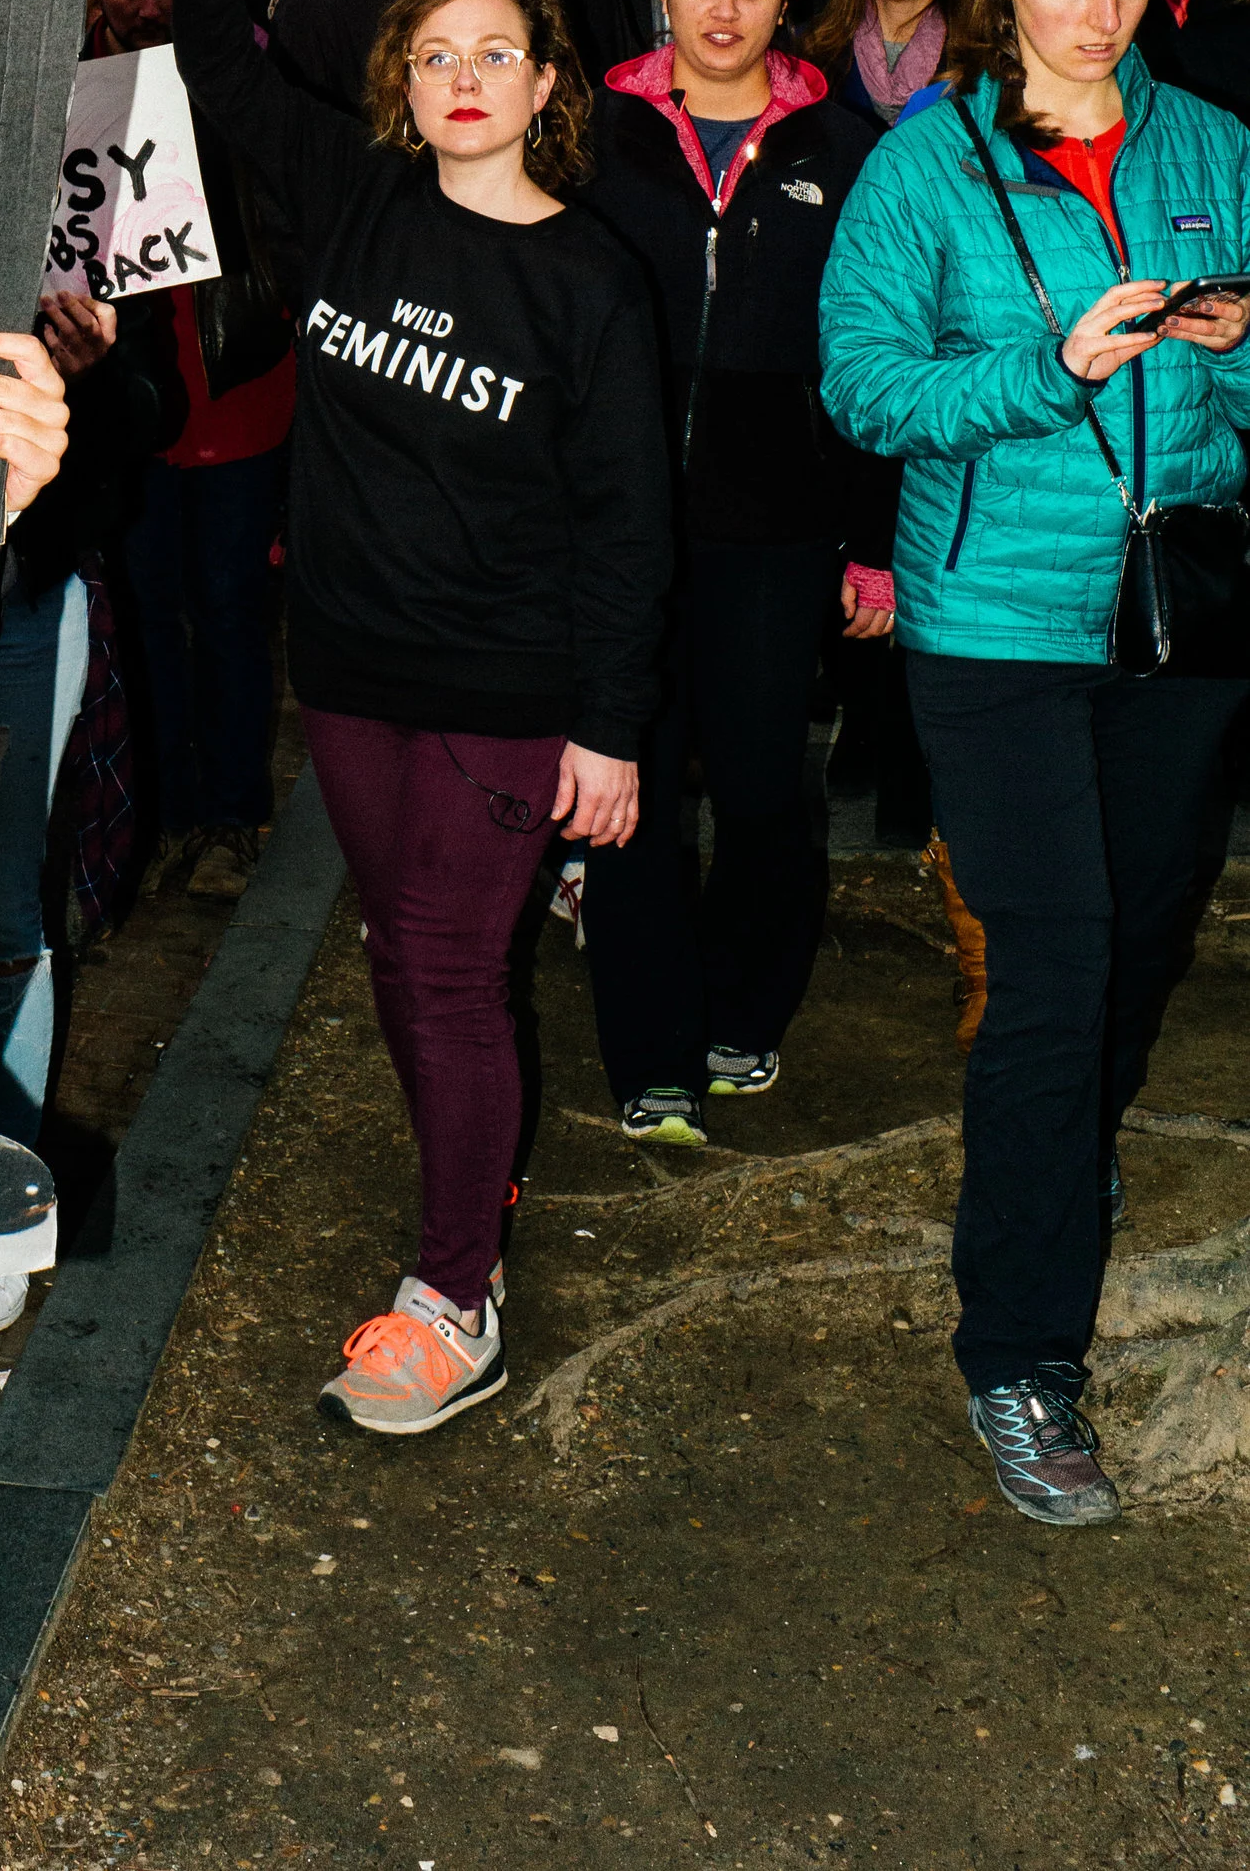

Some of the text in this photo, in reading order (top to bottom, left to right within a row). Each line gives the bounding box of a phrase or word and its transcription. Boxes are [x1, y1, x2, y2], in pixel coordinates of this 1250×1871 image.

[55, 138, 157, 212] SY
[83, 221, 211, 302] BACK
[391, 298, 454, 338] WILD
[306, 298, 525, 422] FEMINIST
